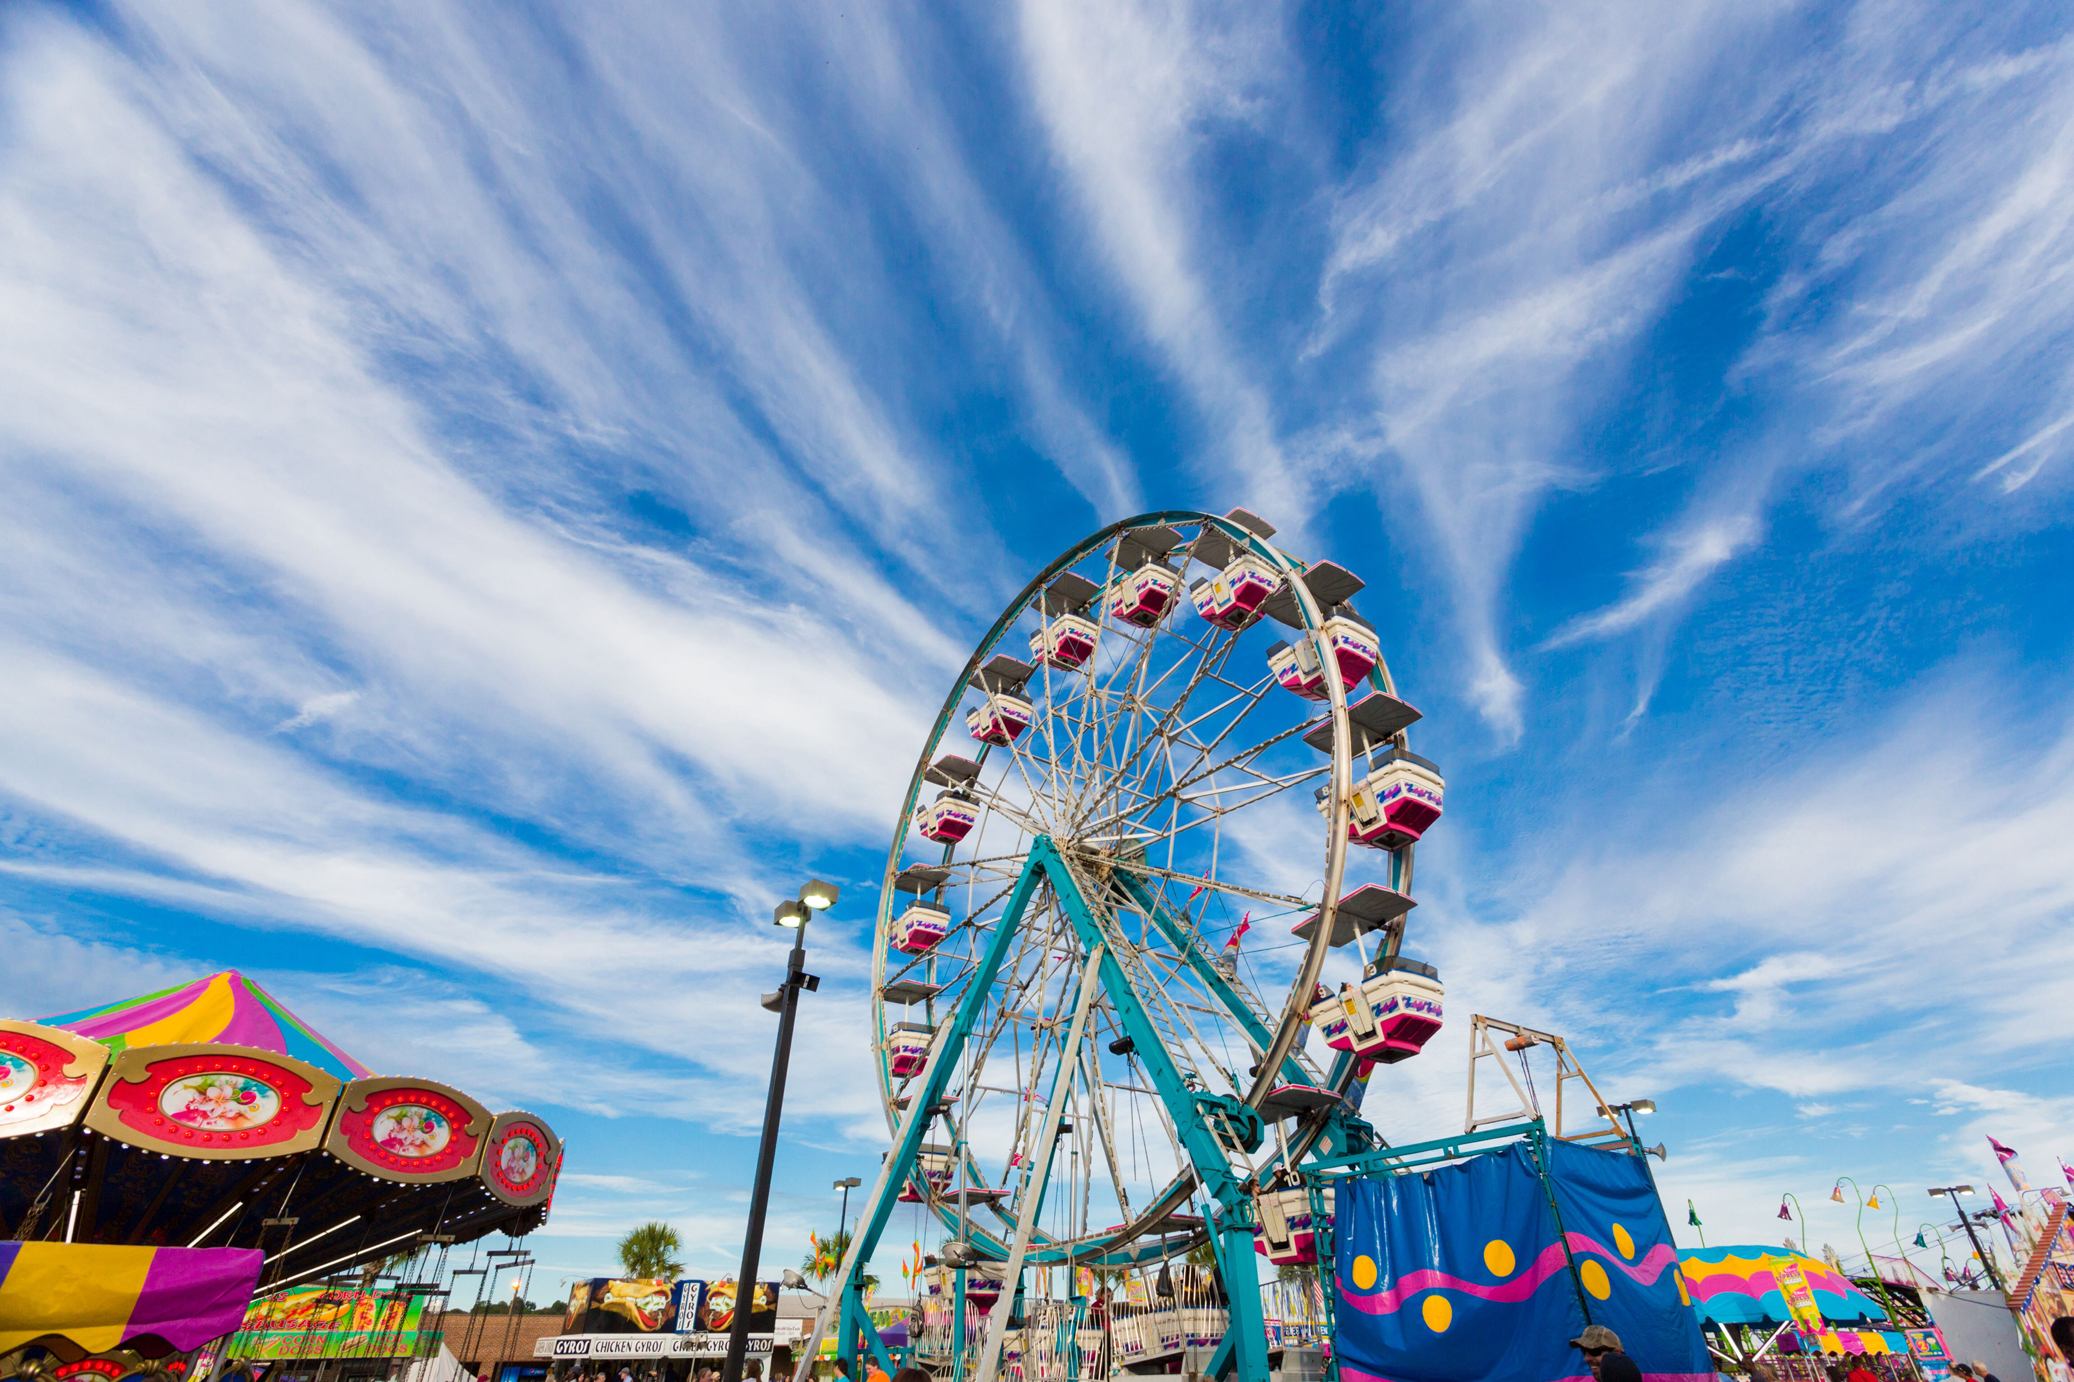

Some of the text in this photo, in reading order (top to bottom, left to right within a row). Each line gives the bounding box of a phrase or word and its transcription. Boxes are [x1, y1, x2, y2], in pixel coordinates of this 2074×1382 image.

[1321, 785, 1330, 796] 8
[1317, 987, 1327, 998] 9
[1283, 1171, 1301, 1187] 10
[678, 1284, 688, 1329] GYROS
[686, 1283, 698, 1328] GYROS
[241, 1319, 342, 1331] SAUSAGE
[281, 1334, 327, 1345] CORN
[375, 1334, 406, 1343] HOT
[278, 1345, 323, 1355] DOGS
[366, 1344, 408, 1354] DOGS
[556, 1340, 590, 1353] GYROS
[595, 1340, 663, 1353] CHICKEN GYROS
[706, 1340, 730, 1351] GYRO
[745, 1339, 772, 1351] YROS
[1918, 1341, 1927, 1350] 2
